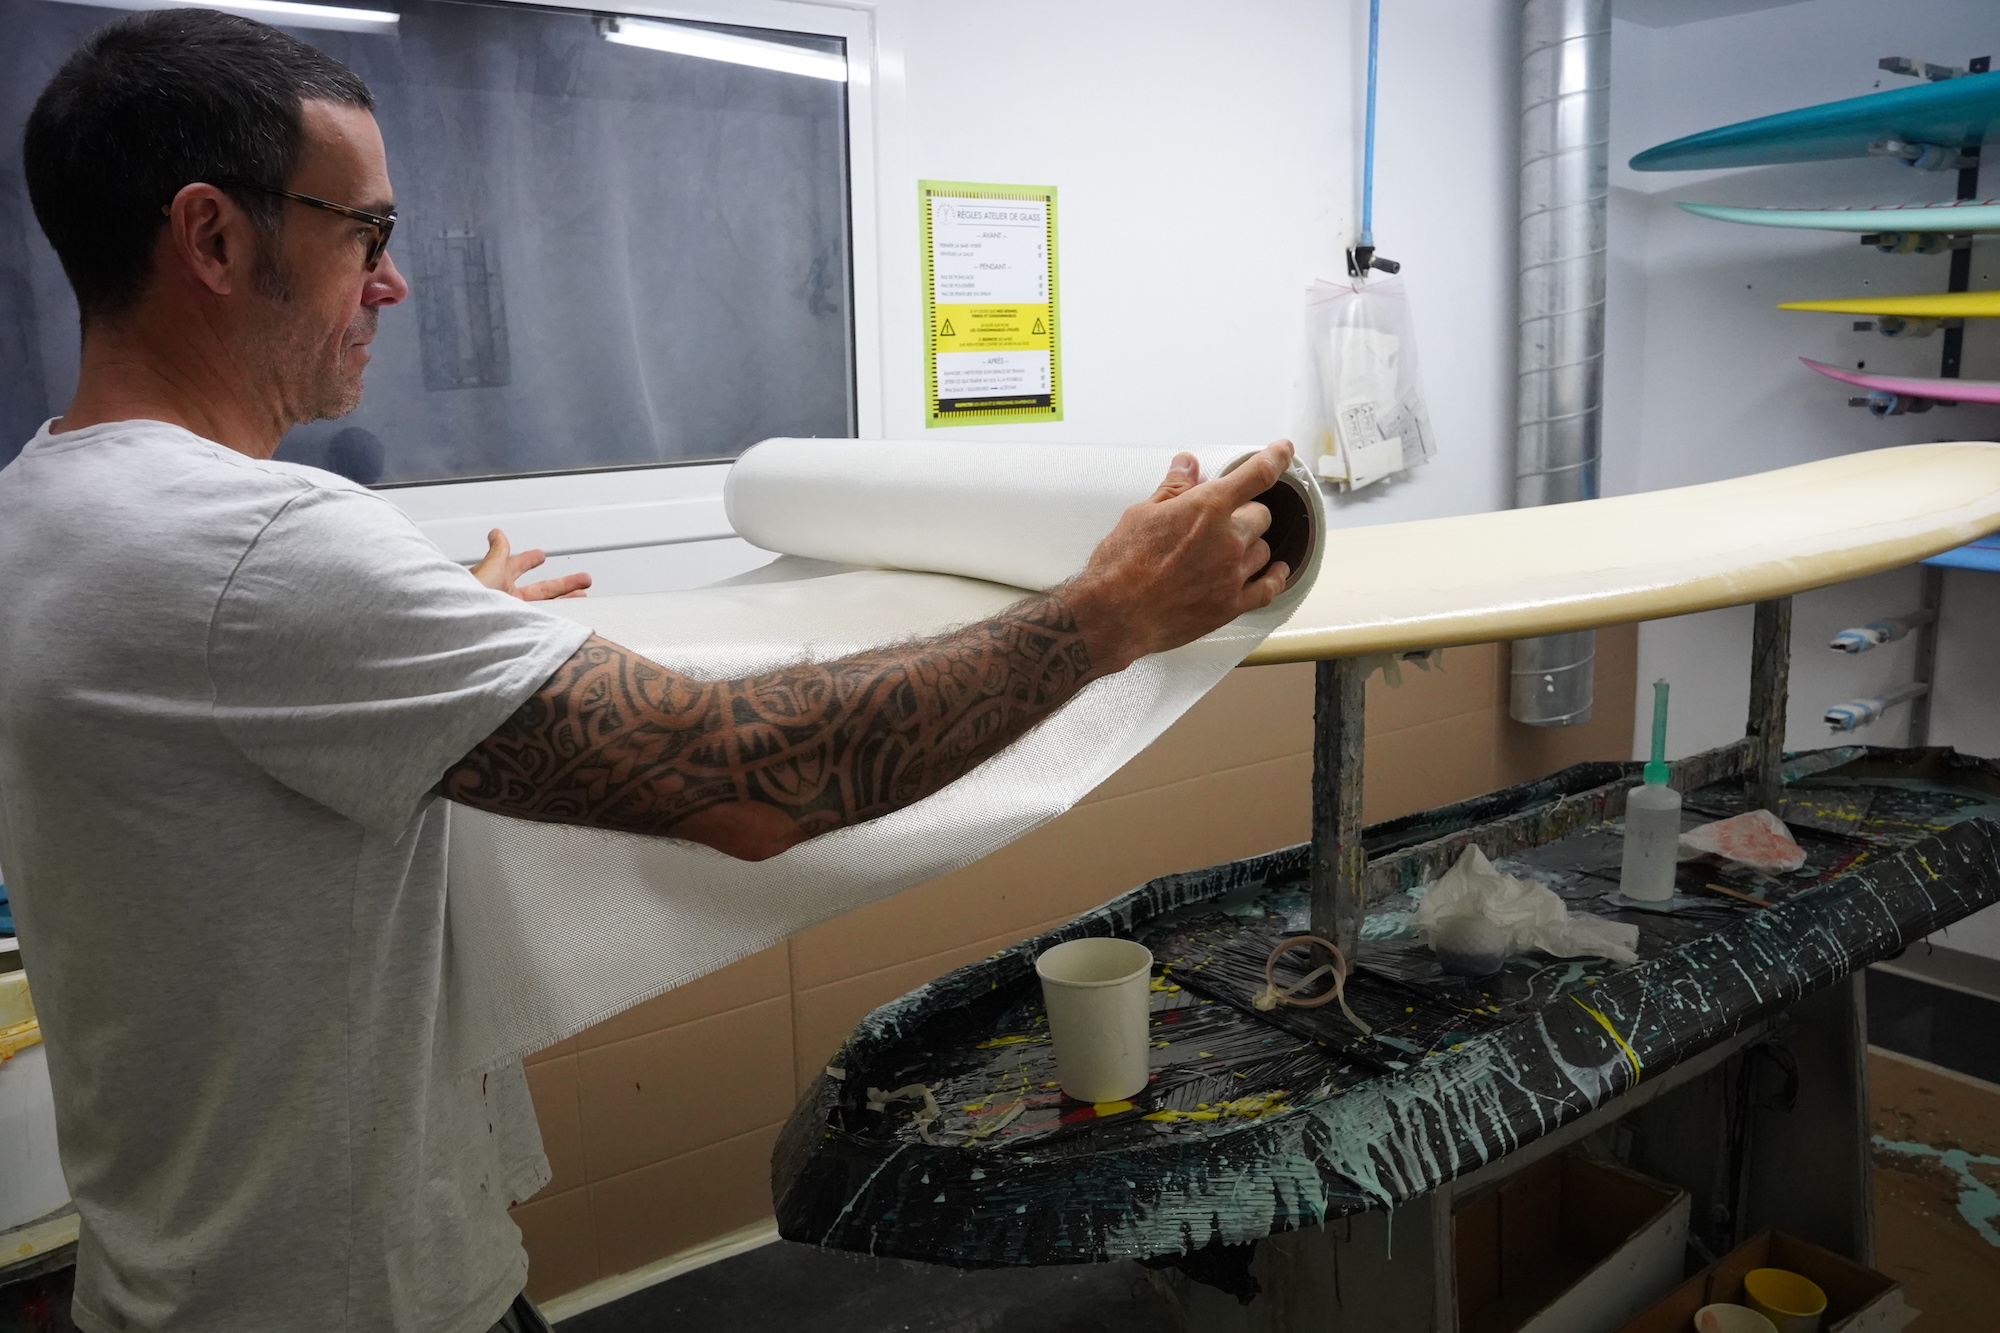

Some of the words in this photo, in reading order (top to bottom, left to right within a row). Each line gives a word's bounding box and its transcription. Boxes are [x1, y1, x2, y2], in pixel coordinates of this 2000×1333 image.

[984, 211, 1008, 220] ATELIER
[1009, 212, 1018, 221] DE
[1019, 213, 1041, 222] GLASS
